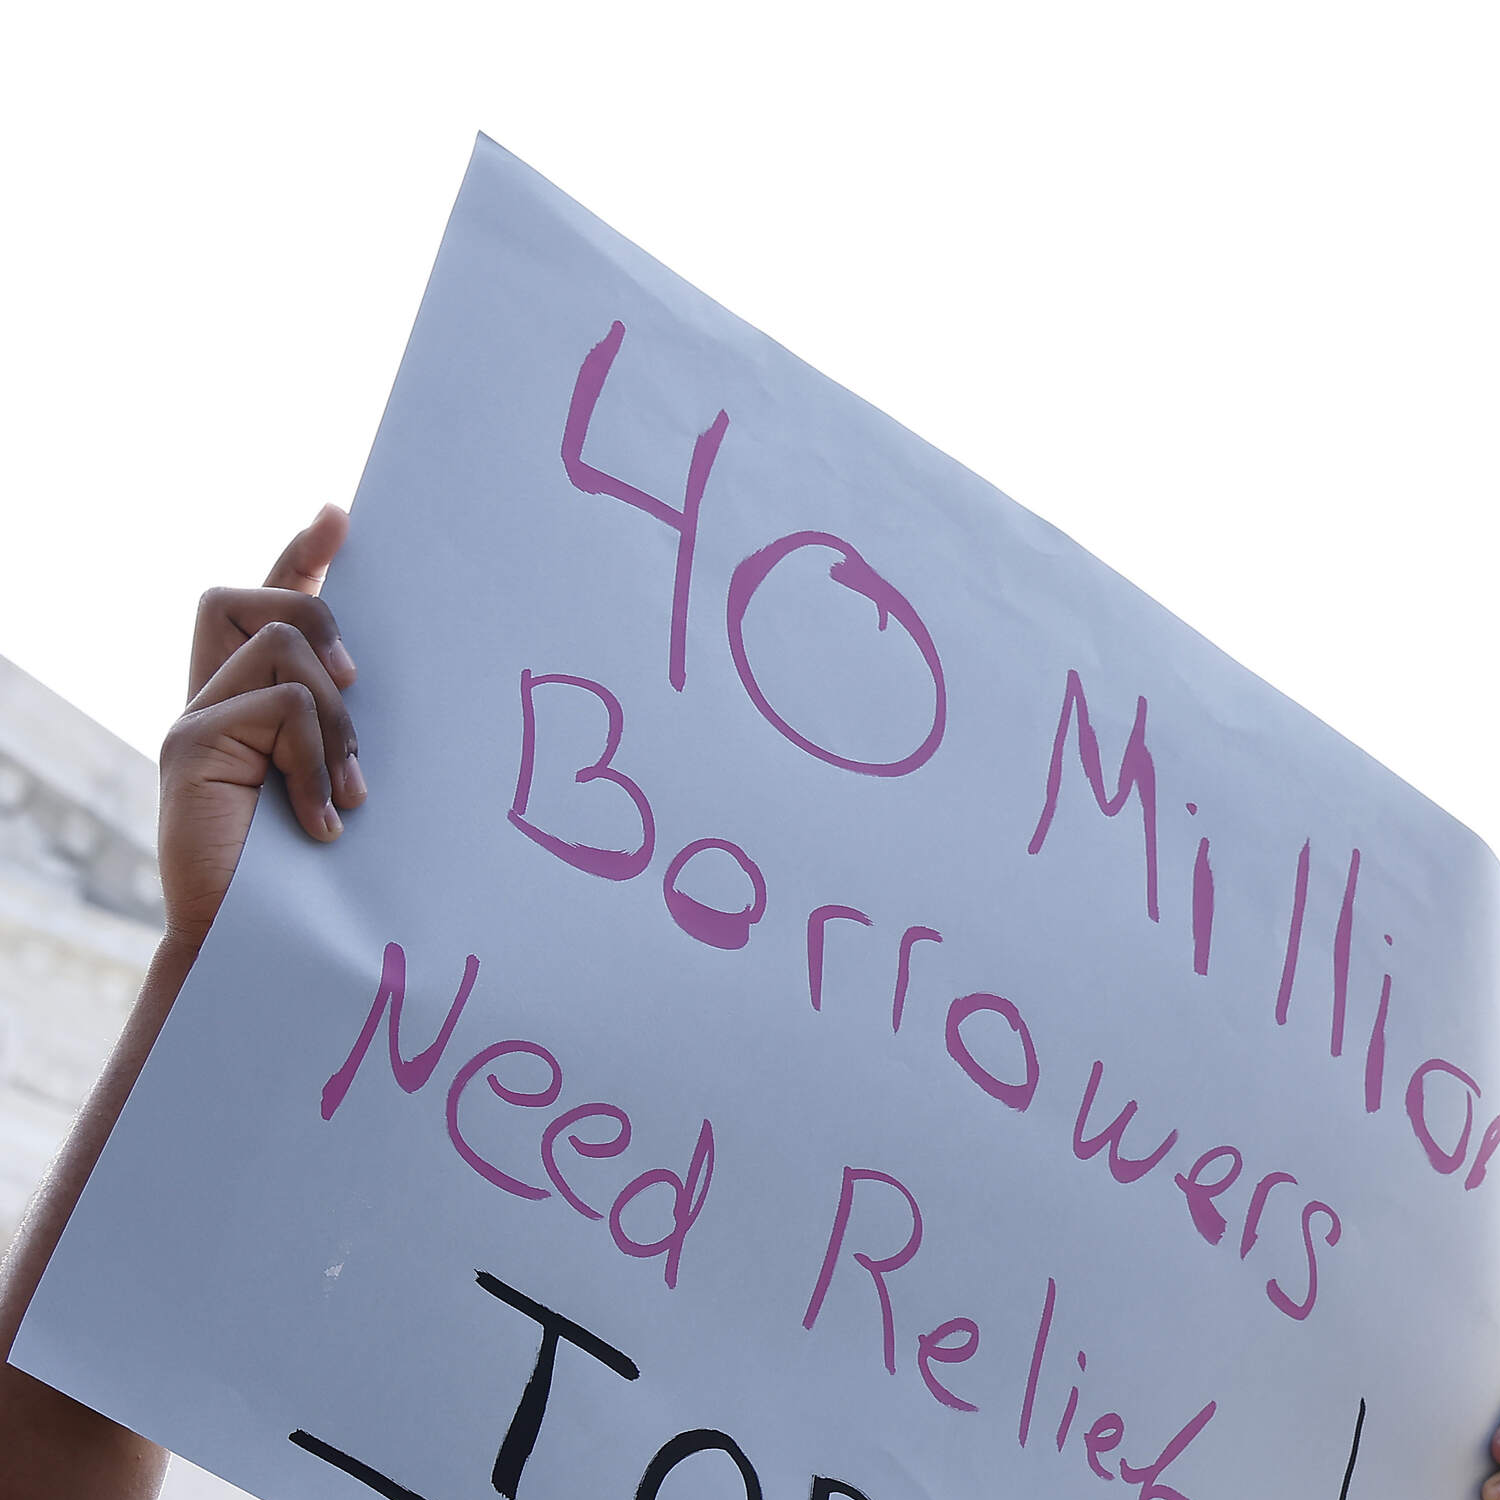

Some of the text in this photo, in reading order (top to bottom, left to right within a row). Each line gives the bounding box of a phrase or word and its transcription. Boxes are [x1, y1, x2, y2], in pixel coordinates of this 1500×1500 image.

[562, 320, 948, 777] 40
[320, 942, 714, 1288] Need
[508, 668, 1342, 1321] Borrowers
